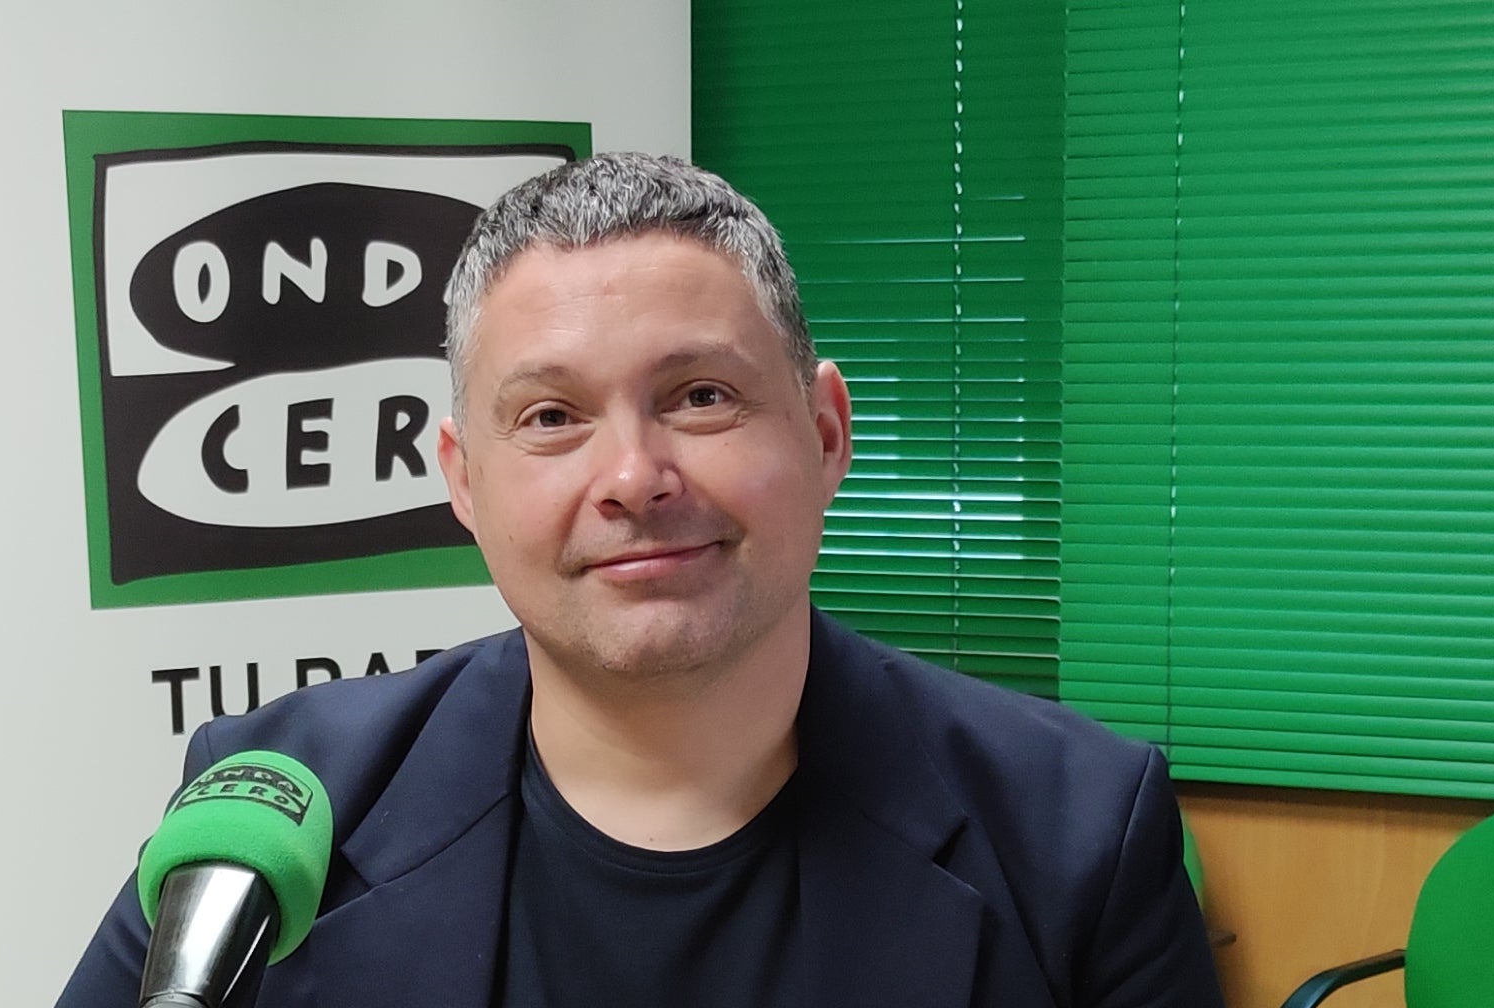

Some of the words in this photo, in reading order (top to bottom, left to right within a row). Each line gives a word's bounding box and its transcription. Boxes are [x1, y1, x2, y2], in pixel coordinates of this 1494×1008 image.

[173, 237, 447, 323] OND
[151, 662, 260, 735] TU
[197, 784, 289, 804] CERO
